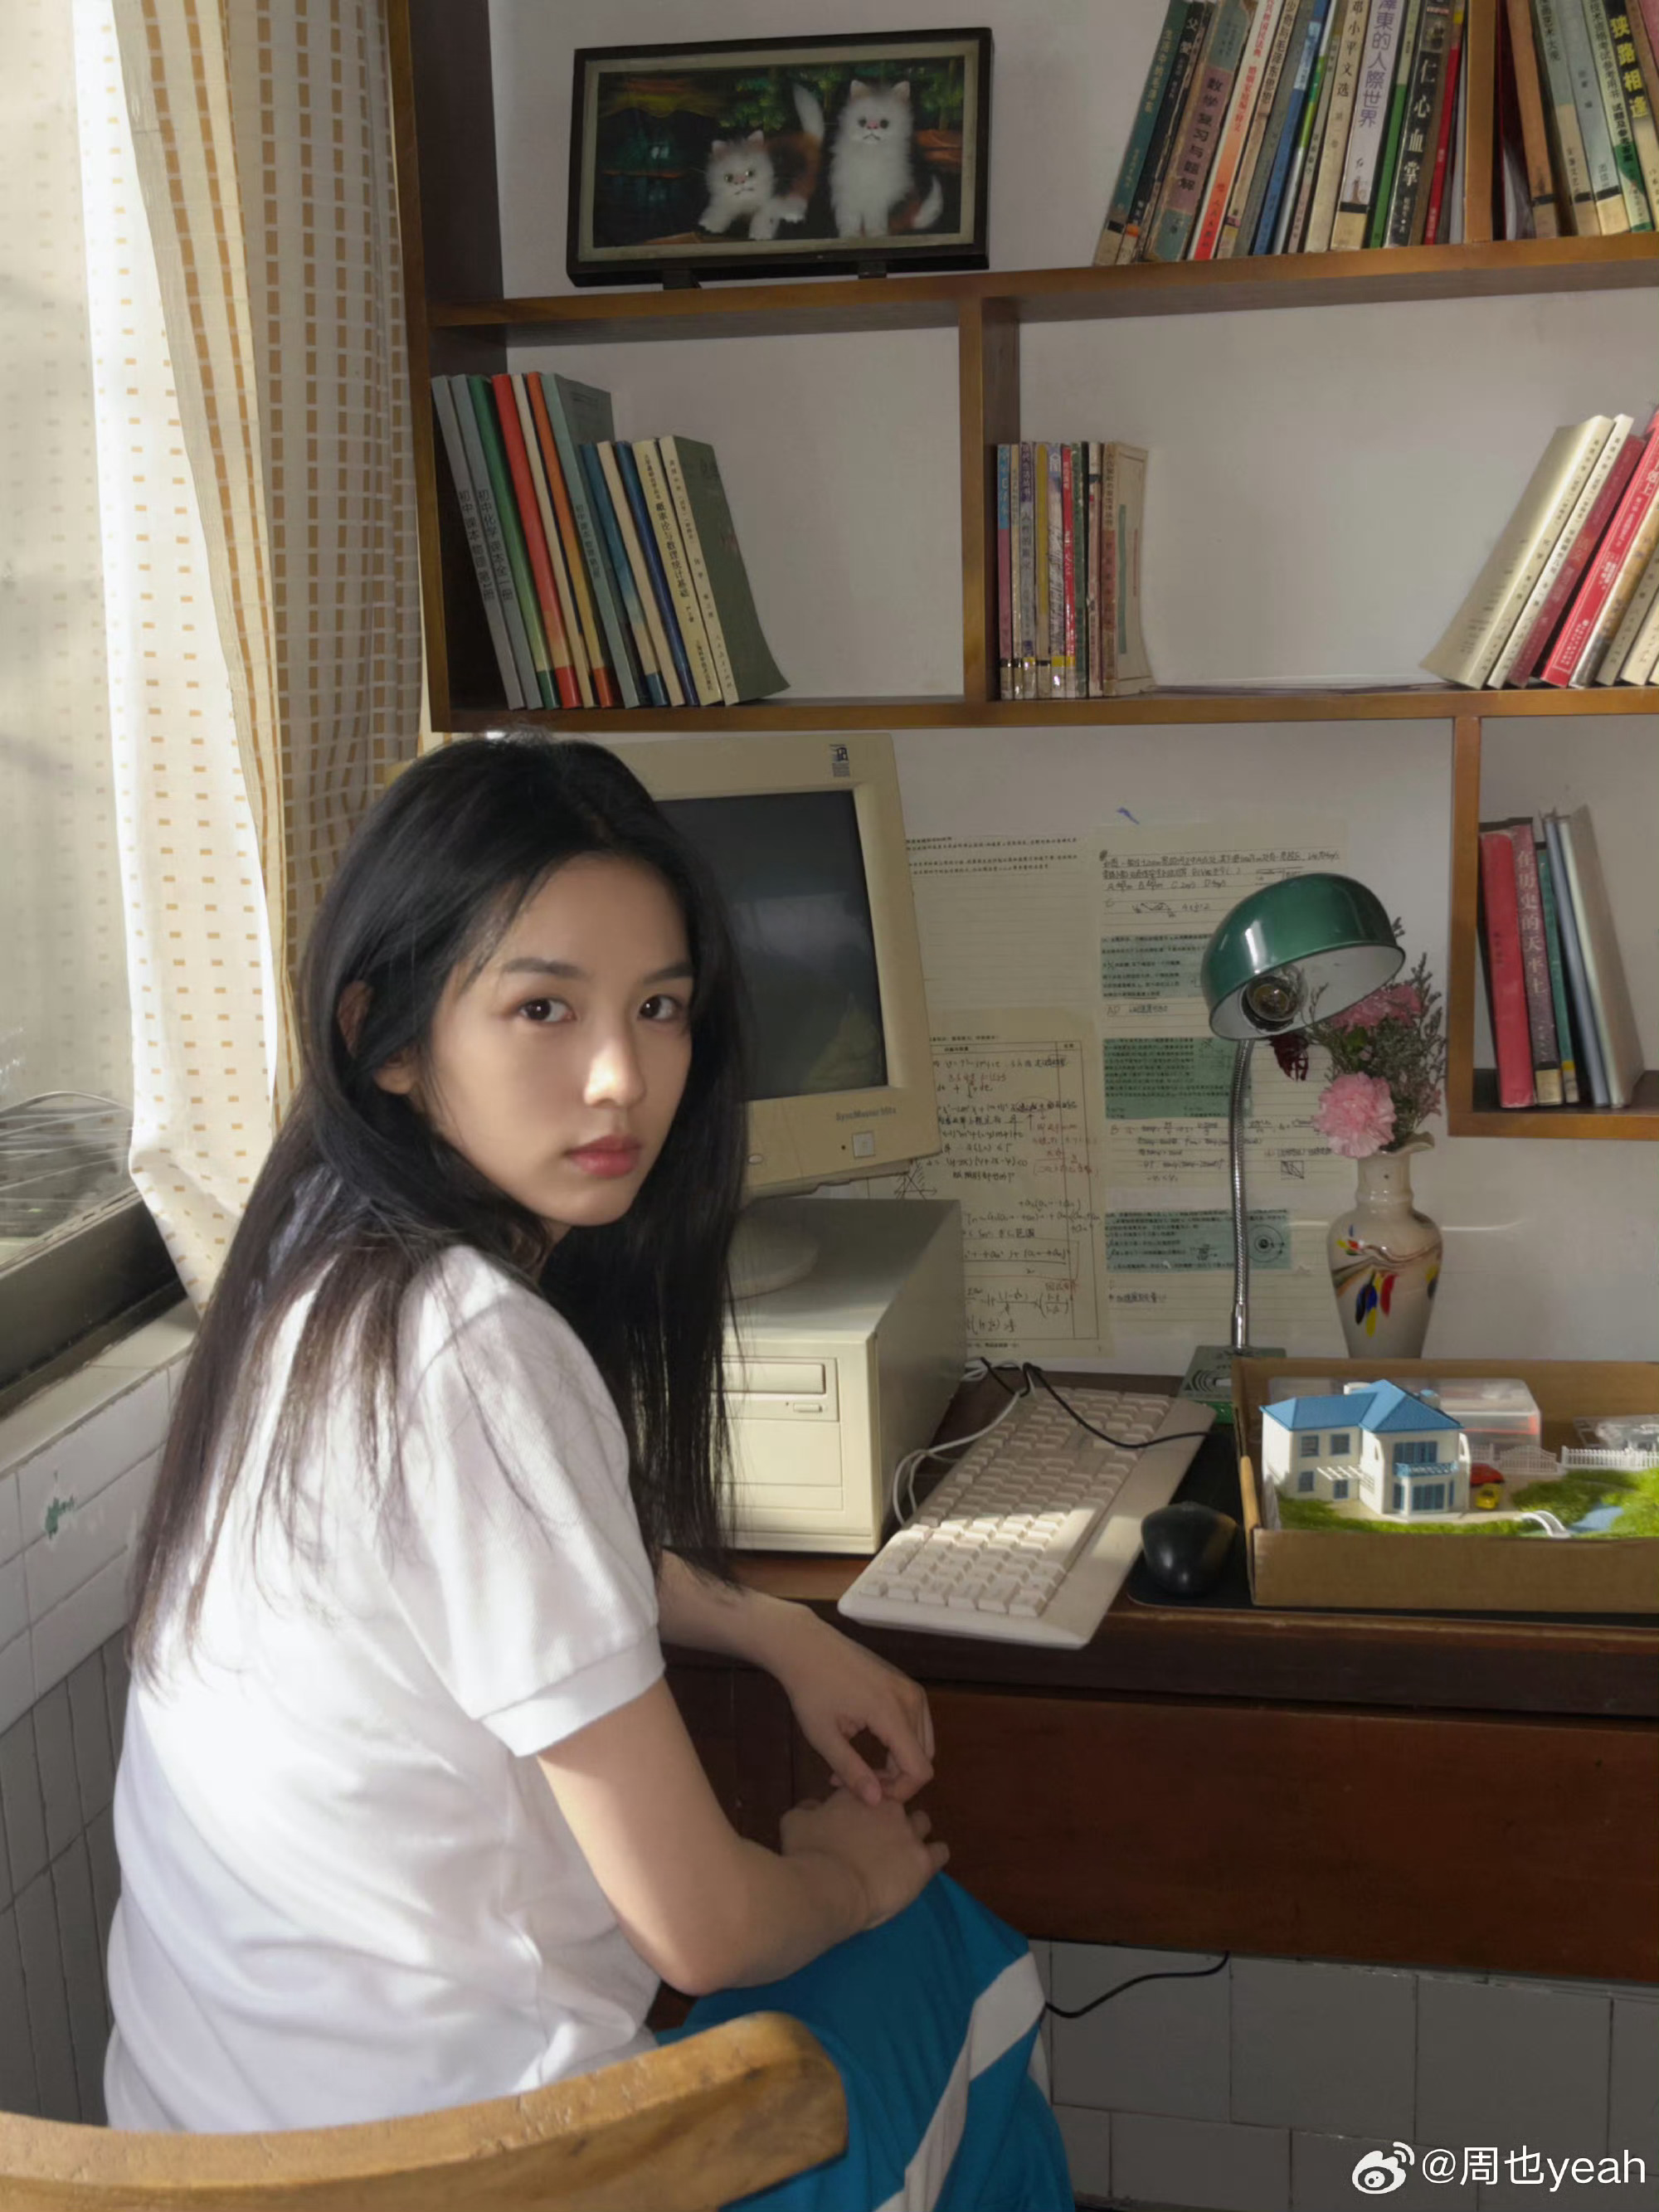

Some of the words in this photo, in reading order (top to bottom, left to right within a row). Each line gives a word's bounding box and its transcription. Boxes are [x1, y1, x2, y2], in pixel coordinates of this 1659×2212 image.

[1337, 1, 1364, 97] 邓小平文选
[1610, 15, 1648, 118] 狭路相逢
[1178, 77, 1224, 191] 数学复习与题解
[654, 503, 690, 598] 概率论与数理统计基础
